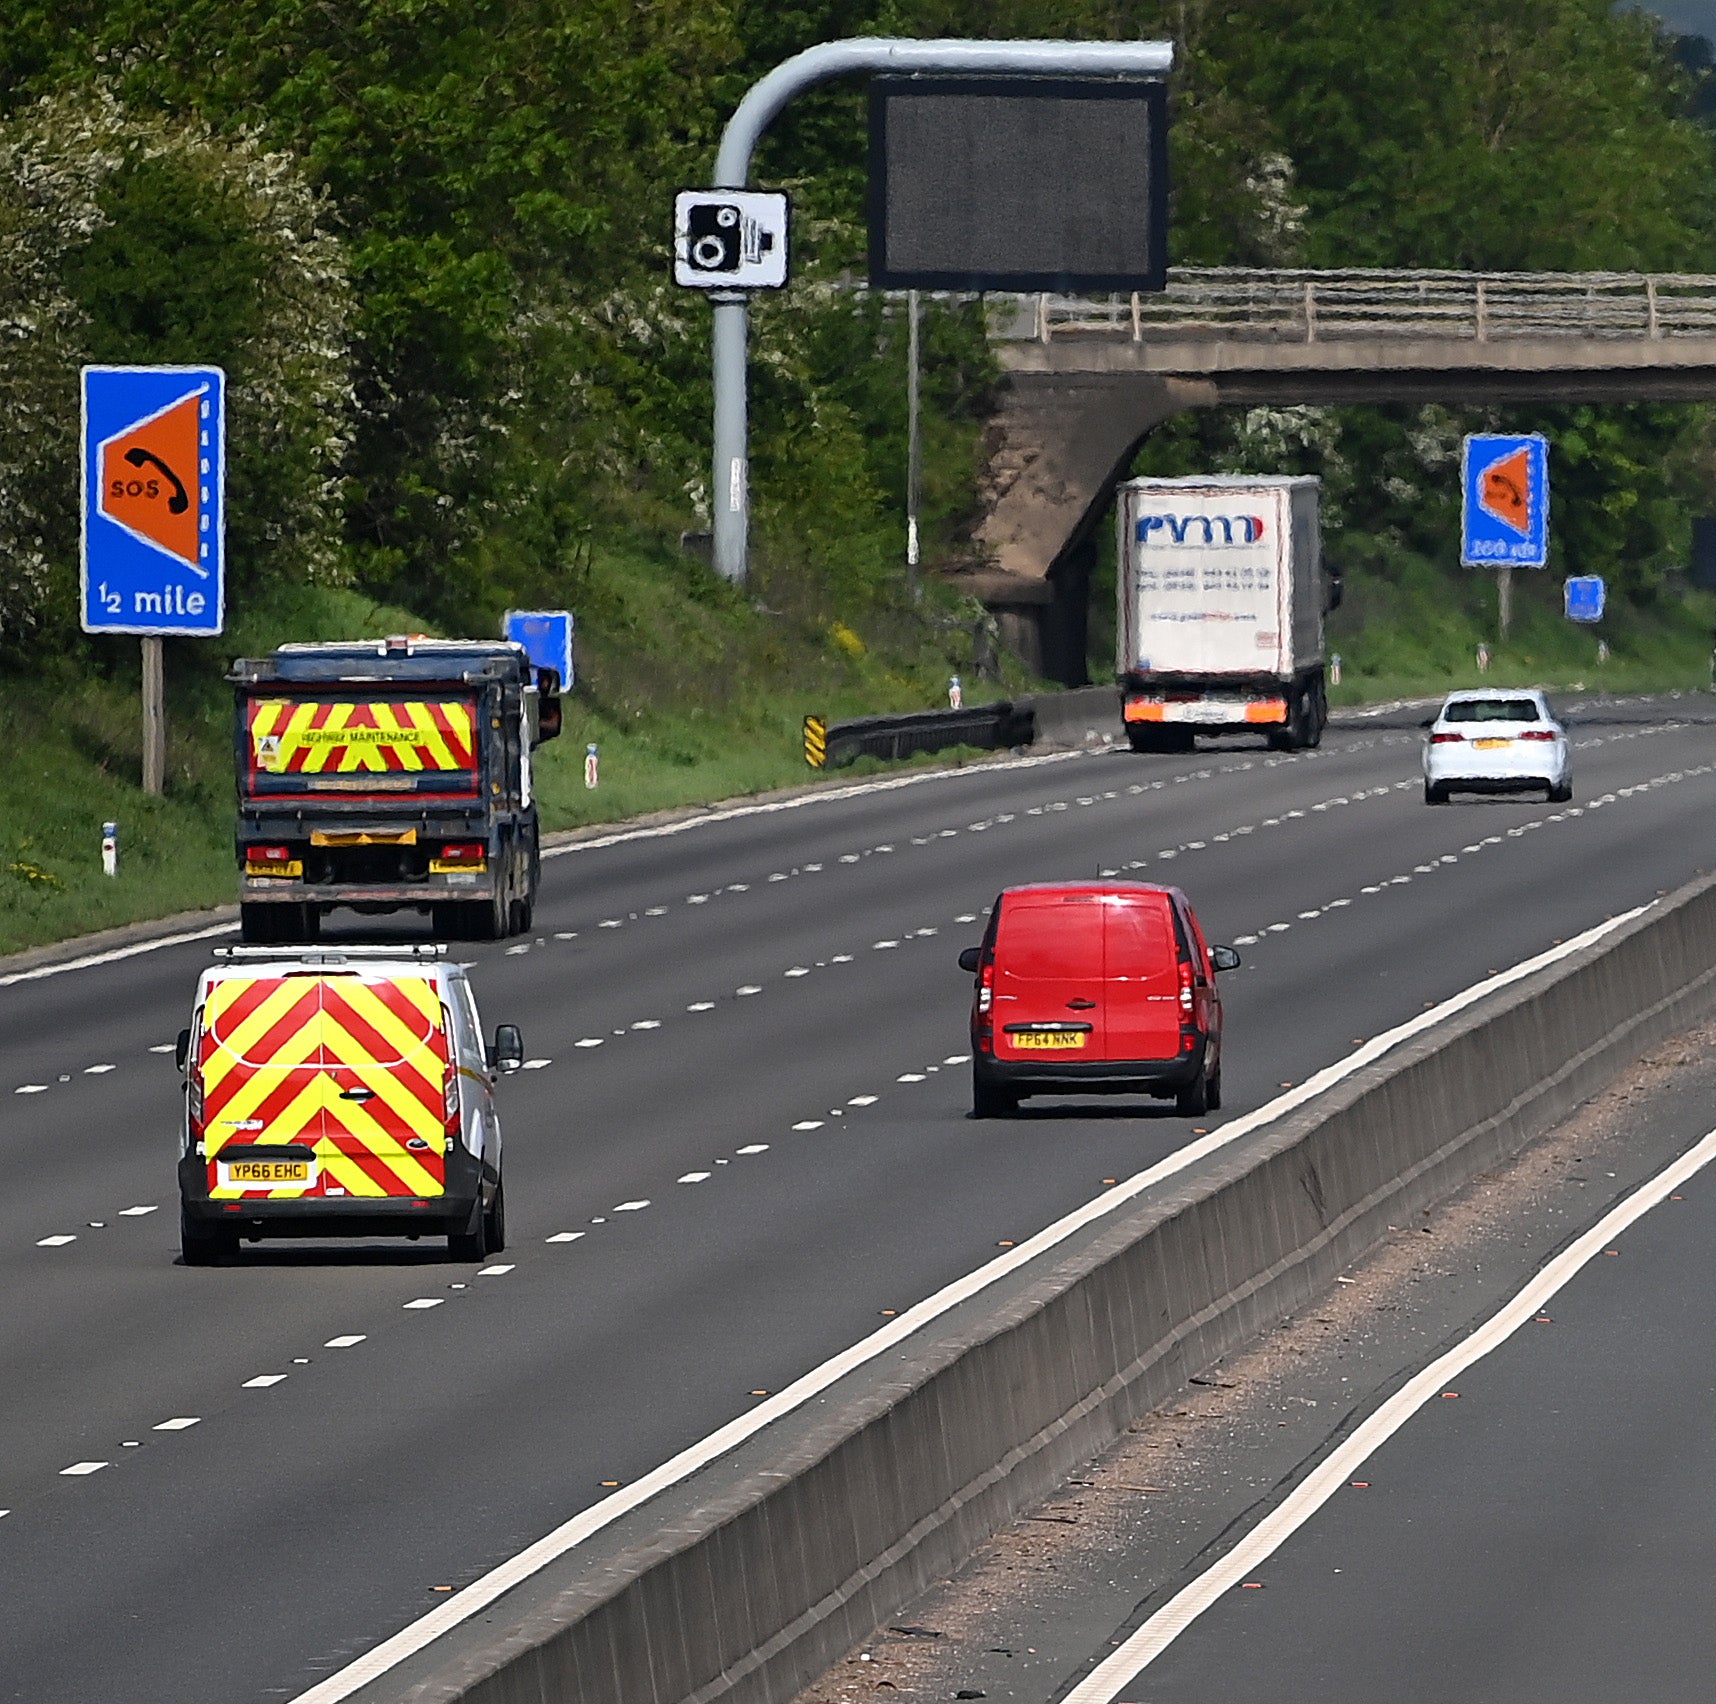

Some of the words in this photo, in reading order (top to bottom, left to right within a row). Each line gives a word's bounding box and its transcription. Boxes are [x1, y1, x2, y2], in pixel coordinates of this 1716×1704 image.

[111, 480, 160, 499] SOS
[134, 584, 206, 616] mile
[234, 1164, 270, 1178] YP66
[274, 1164, 302, 1178] EHC
